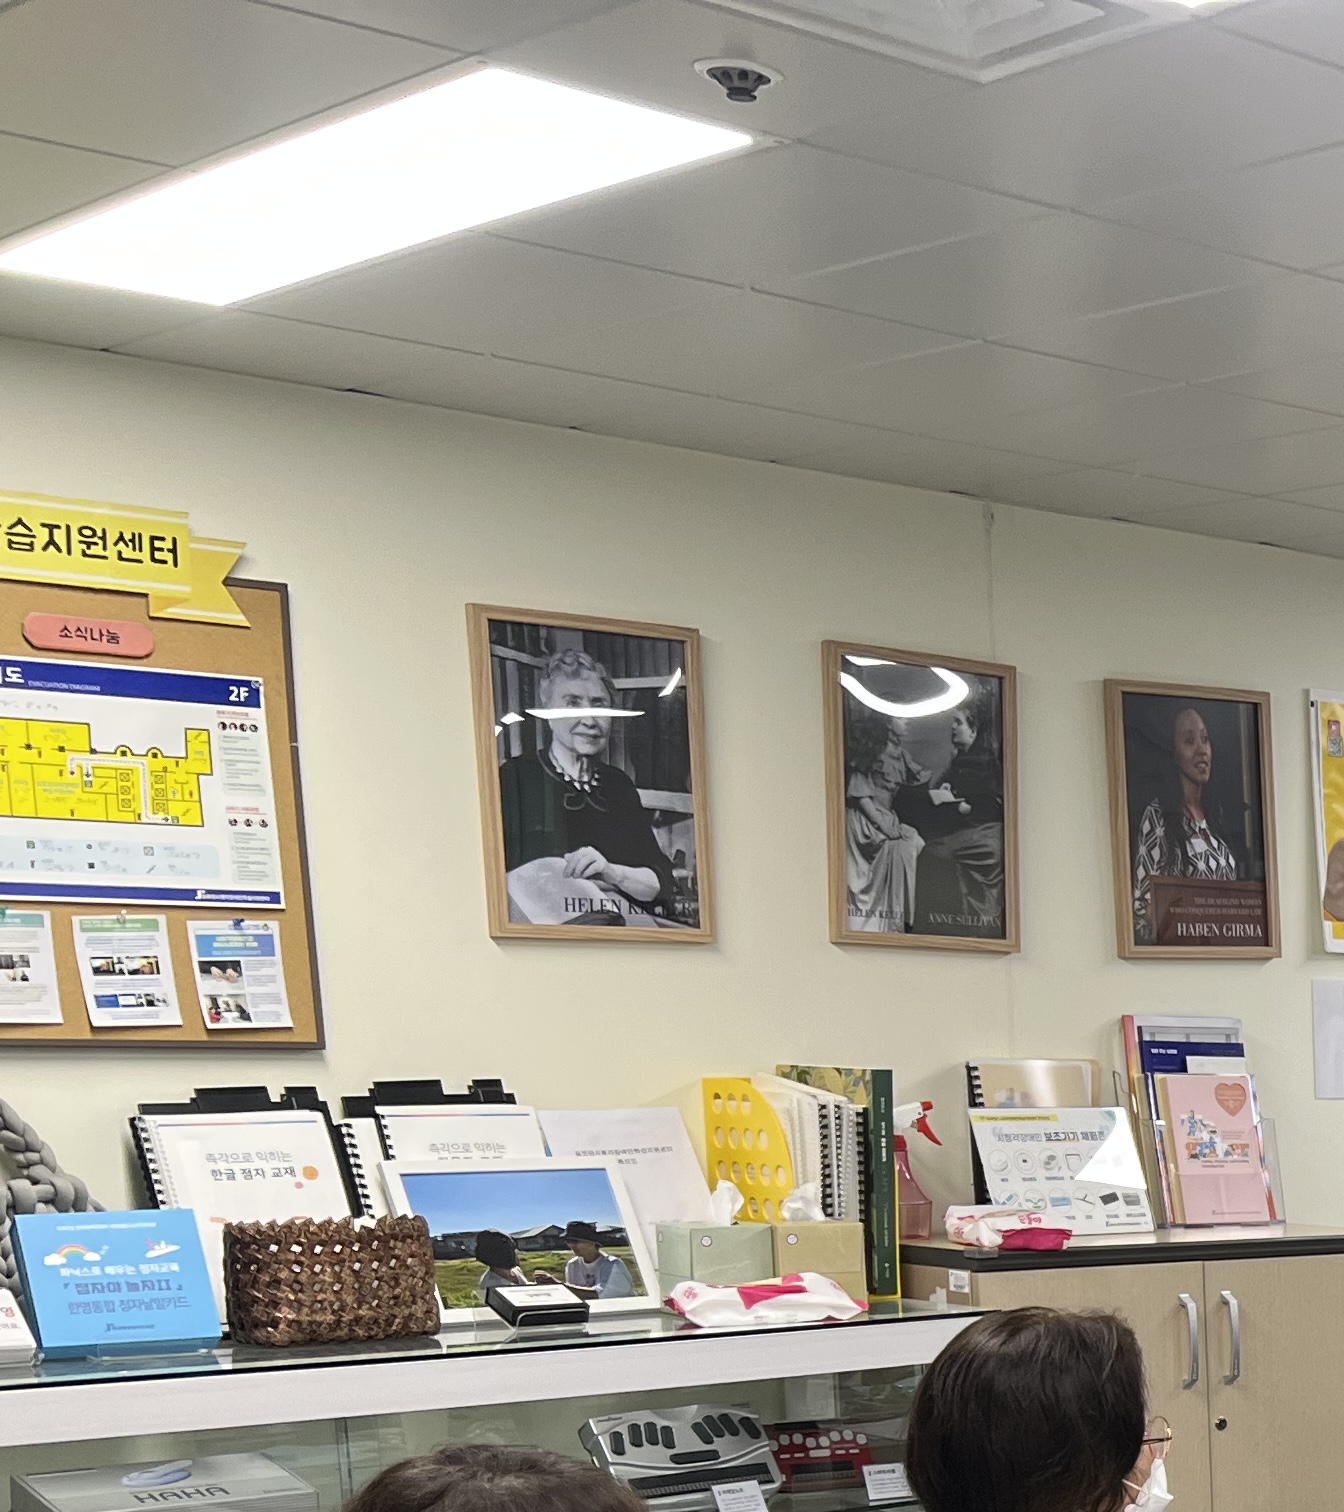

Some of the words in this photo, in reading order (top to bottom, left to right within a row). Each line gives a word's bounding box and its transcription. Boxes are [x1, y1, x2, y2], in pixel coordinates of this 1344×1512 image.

[0, 516, 180, 569] 습지원센터
[58, 625, 121, 645] 소식나눔
[228, 685, 249, 702] 2F
[564, 896, 622, 914] HELEN
[928, 912, 956, 925] ANNE
[956, 914, 1001, 927] SULLIVAN
[1177, 922, 1220, 937] HABEN
[1223, 923, 1262, 937] GIRMA
[1044, 1131, 1080, 1143] 보조기기
[205, 1151, 255, 1165] 촉각으로
[255, 1150, 293, 1164] 익히는
[210, 1168, 237, 1181] 한글
[240, 1168, 266, 1181] 점자
[271, 1166, 297, 1178] 교재
[133, 1486, 231, 1504] HAHA
